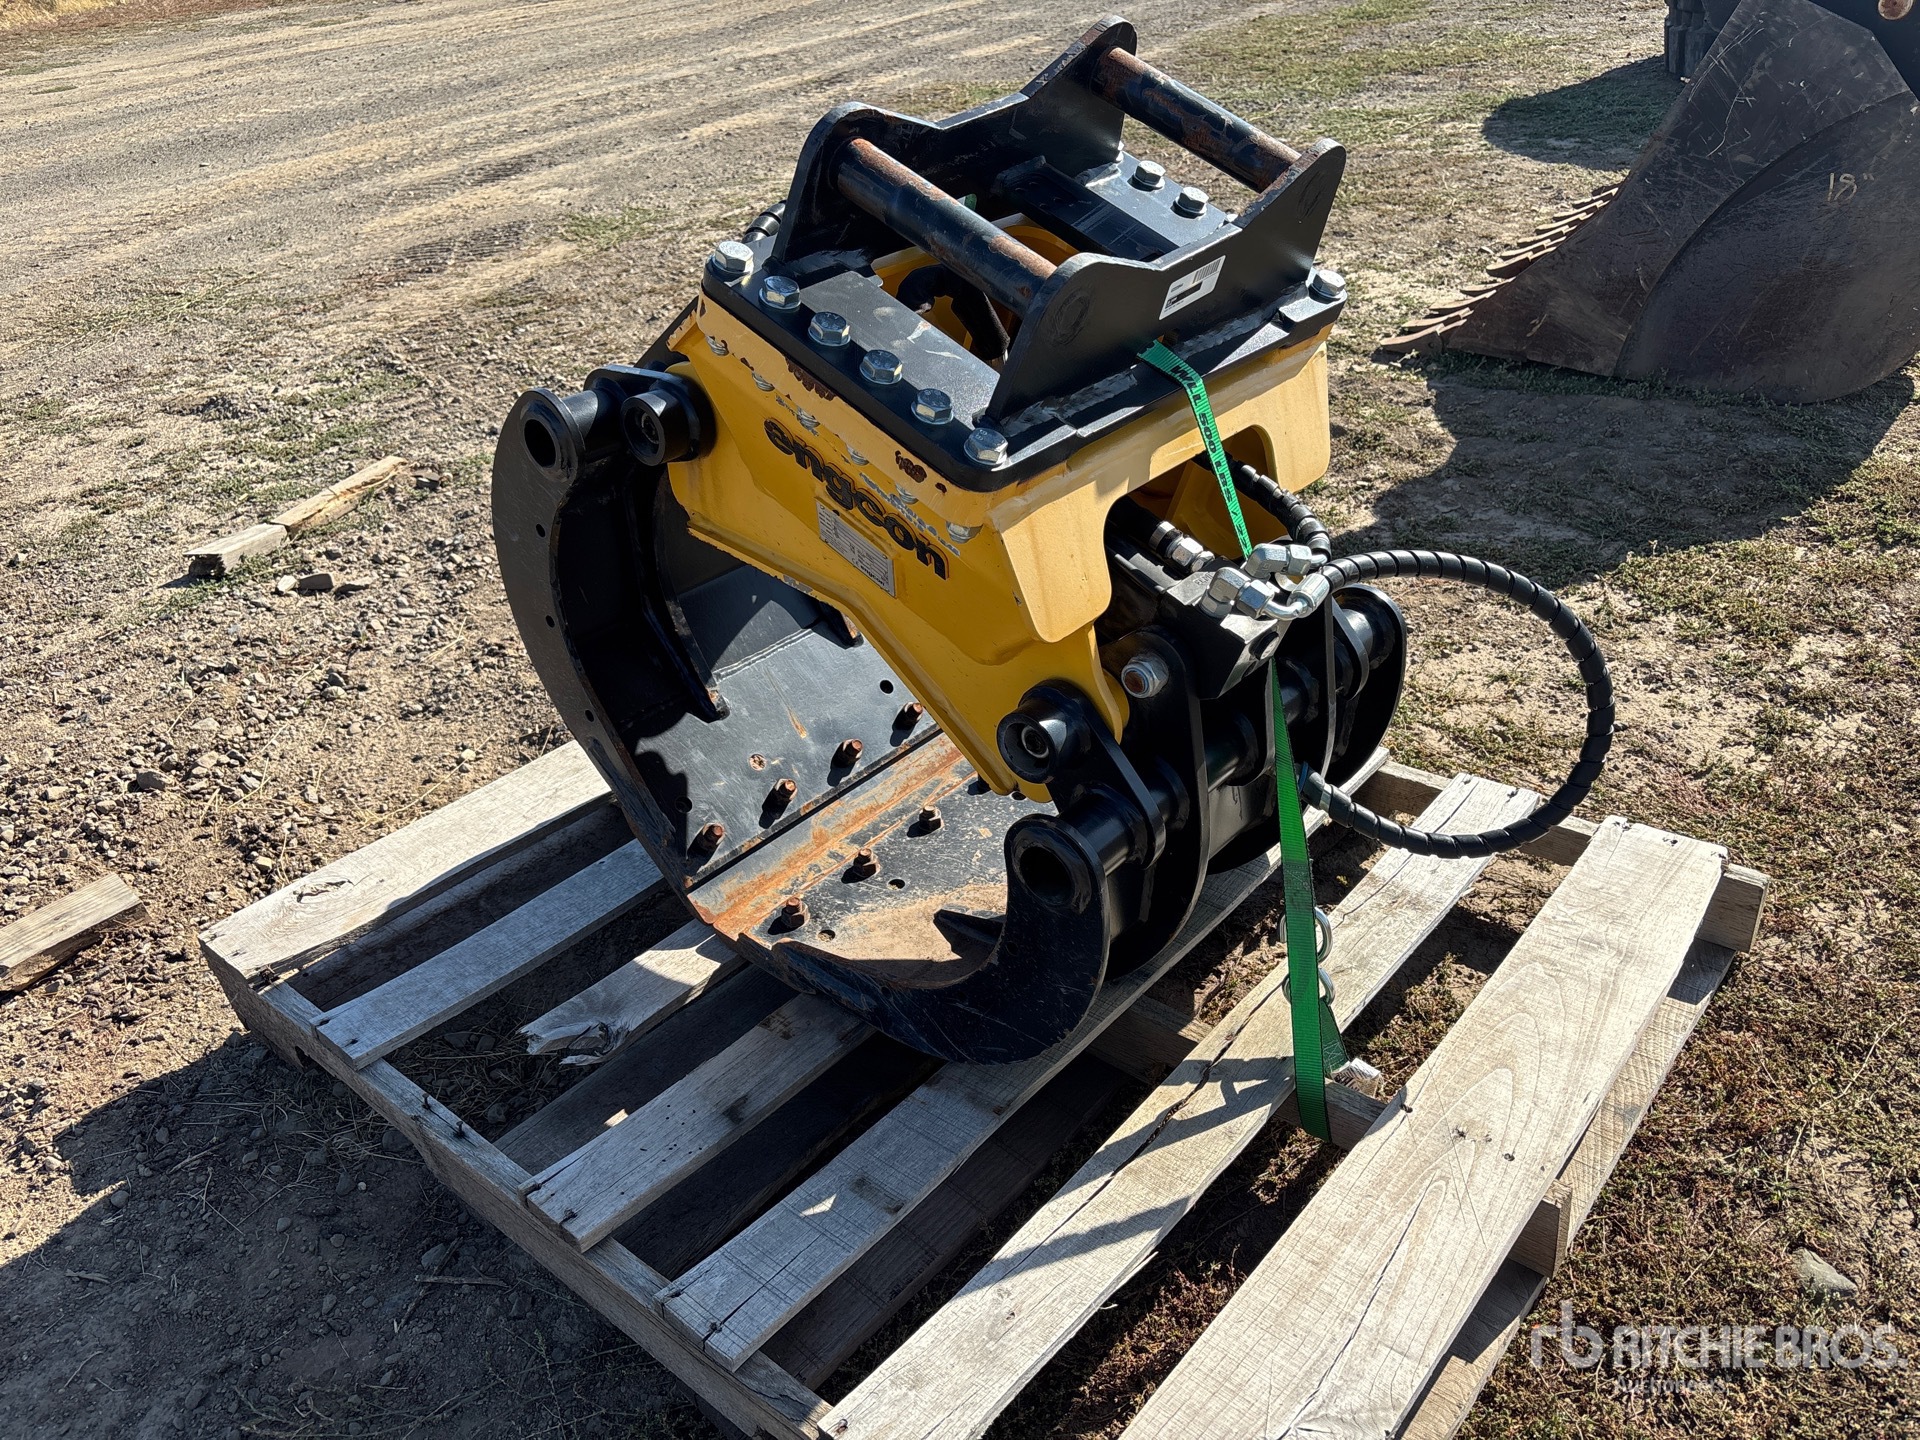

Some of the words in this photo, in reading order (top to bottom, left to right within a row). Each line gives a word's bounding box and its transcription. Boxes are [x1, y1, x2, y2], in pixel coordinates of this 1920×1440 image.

[763, 417, 949, 580] engcon
[1171, 365, 1202, 403] WLL
[1198, 412, 1217, 454] 500
[1214, 460, 1233, 503] LBS
[860, 565, 885, 587] engcon
